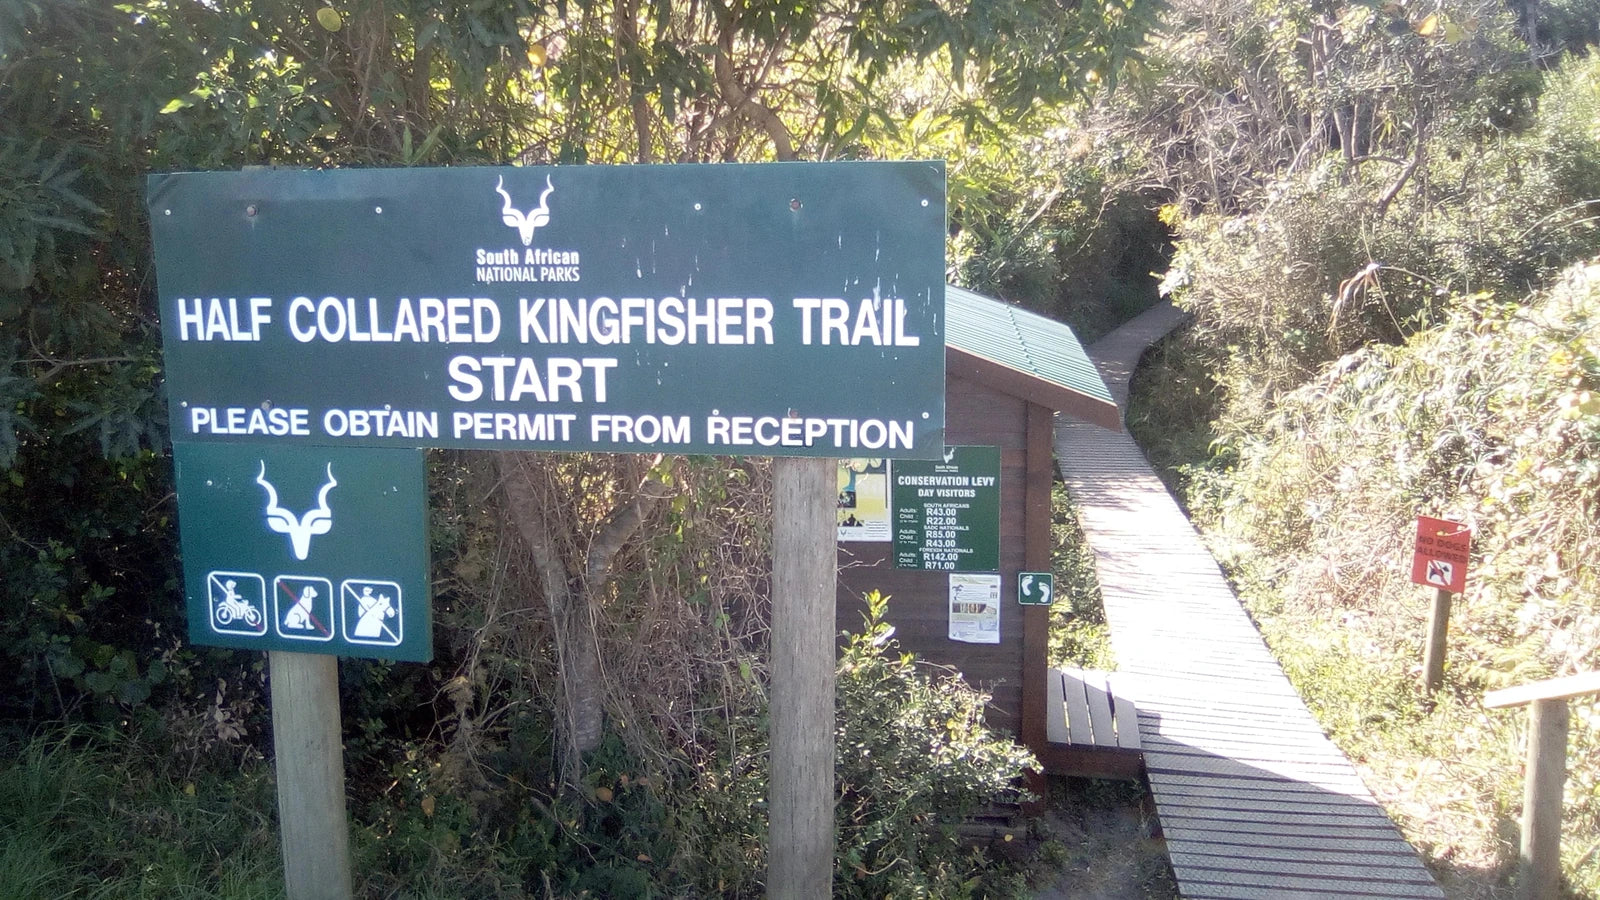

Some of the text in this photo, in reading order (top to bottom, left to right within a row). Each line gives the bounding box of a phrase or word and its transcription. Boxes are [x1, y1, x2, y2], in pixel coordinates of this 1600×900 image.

[476, 248, 580, 265] South African
[476, 267, 580, 282] NATIONAL PARKS
[177, 296, 920, 347] HALF COLLARED KINGFISHER TRAIL
[447, 355, 618, 403] START
[191, 407, 914, 450] PLEASE OBTAIN PERMIT FROM RECEPTION
[898, 476, 995, 486] CONSERVATION LEVY
[918, 489, 976, 498] DAY VISITORS
[926, 508, 957, 516] R43.00
[926, 517, 957, 525] R22.00
[926, 530, 956, 538] R85.00
[926, 539, 956, 547] R43.00
[1419, 536, 1468, 552] NO DOGS
[923, 553, 958, 561] R142.00
[1417, 546, 1468, 564] ALLOWED
[925, 561, 955, 569] R71.00
